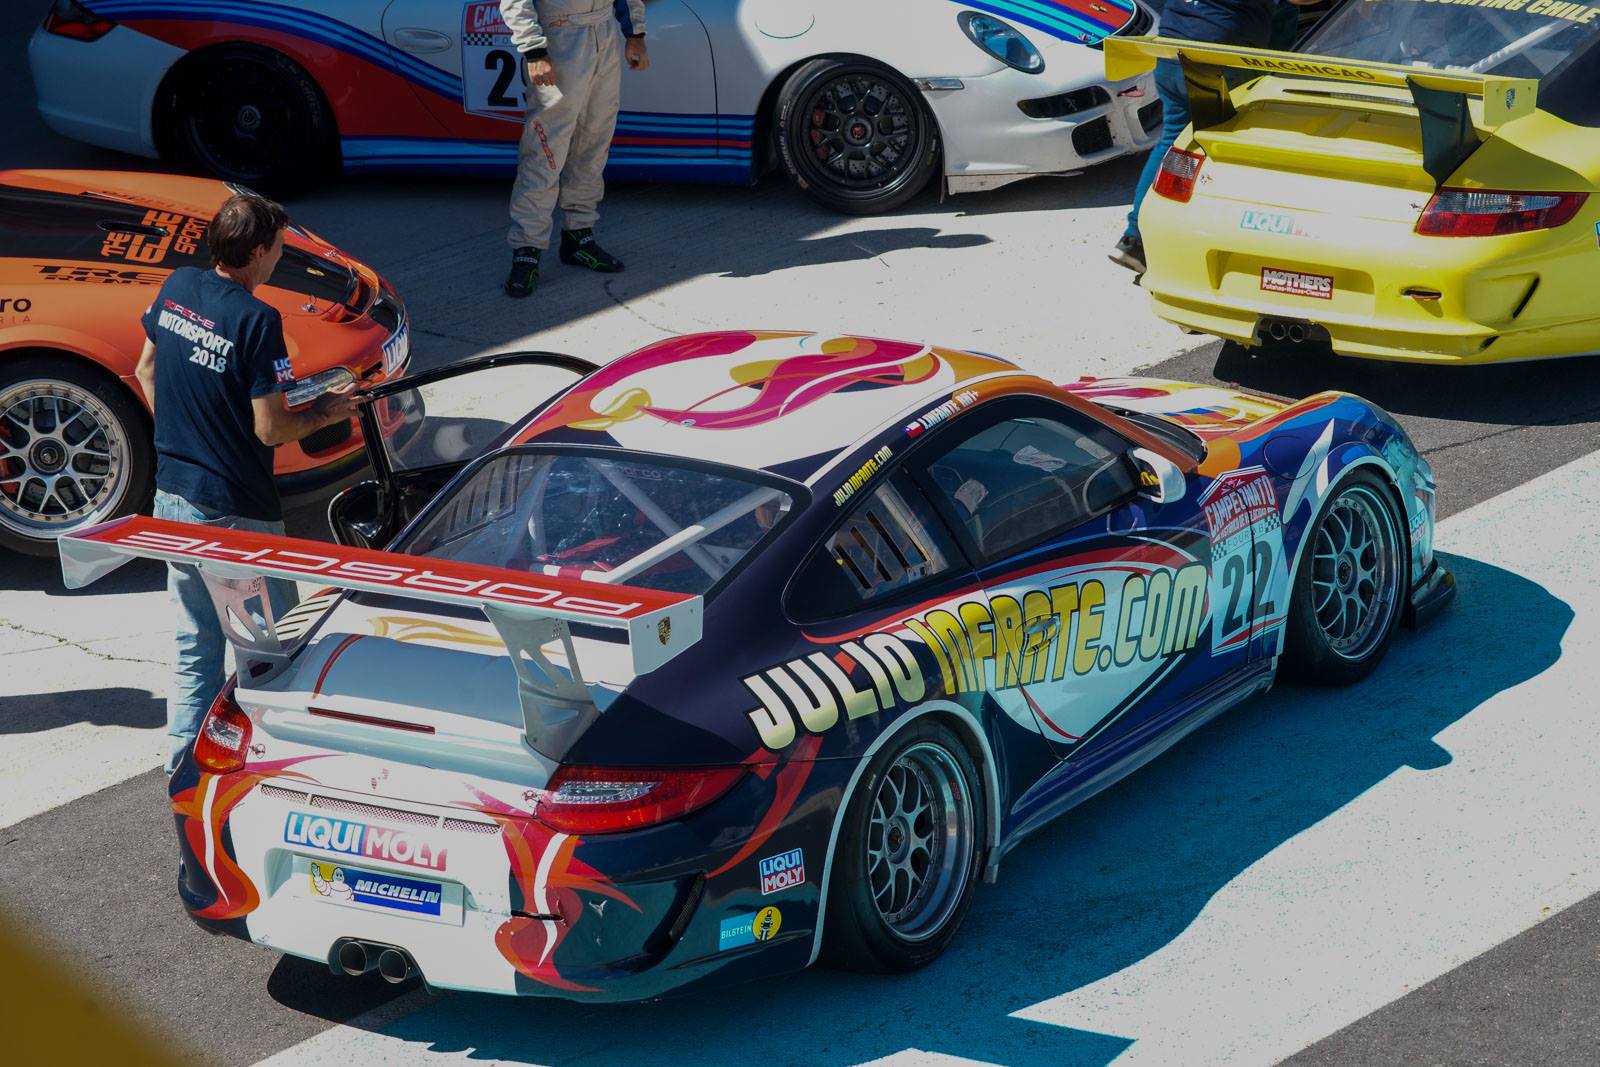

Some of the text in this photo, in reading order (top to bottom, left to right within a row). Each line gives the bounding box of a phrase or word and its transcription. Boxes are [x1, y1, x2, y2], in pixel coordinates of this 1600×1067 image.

[485, 50, 529, 107] 2
[1240, 56, 1376, 80] MACHICAO
[1263, 269, 1331, 292] MOTHERS
[158, 310, 234, 357] MOTORSPORT
[189, 346, 227, 373] 2018
[1204, 475, 1276, 539] CAMPEONATO
[122, 530, 643, 615] PORSCHE
[1221, 540, 1275, 638] 22
[286, 814, 446, 868] LIQUI MOLY
[763, 851, 801, 876] LIQUI
[354, 879, 440, 904] MICHELIN
[765, 867, 802, 892] MOLY
[721, 924, 752, 940] BILSTEIN
